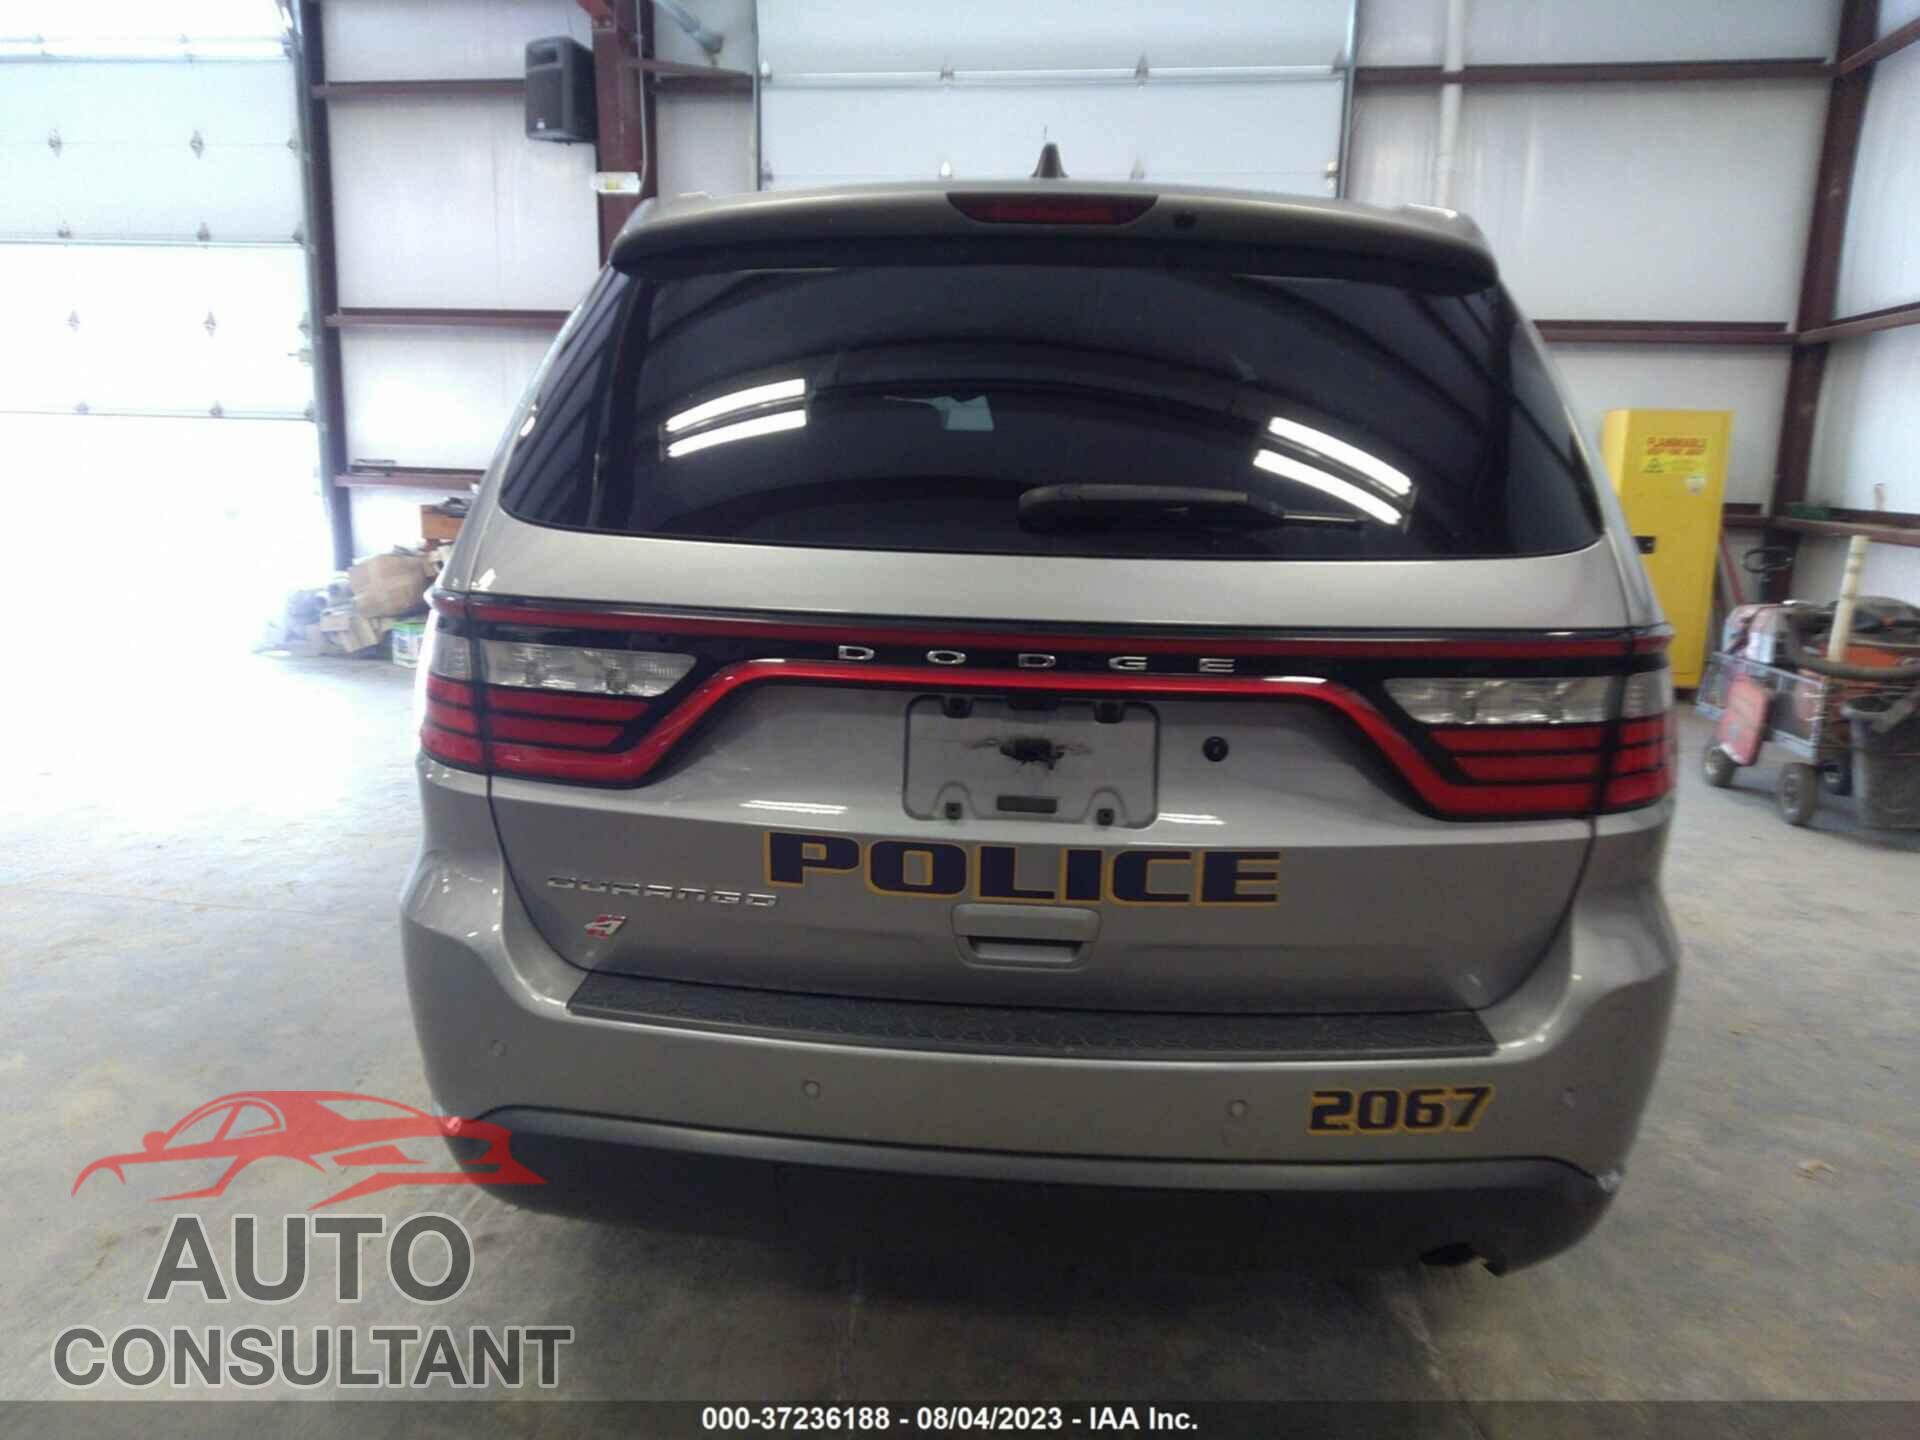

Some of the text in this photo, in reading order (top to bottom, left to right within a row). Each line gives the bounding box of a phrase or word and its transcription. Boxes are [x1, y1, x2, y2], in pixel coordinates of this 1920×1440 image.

[838, 645, 1235, 672] DODGE
[763, 829, 1280, 905] POLICE
[547, 876, 777, 908] DURANGO
[1308, 1084, 1494, 1136] 2067
